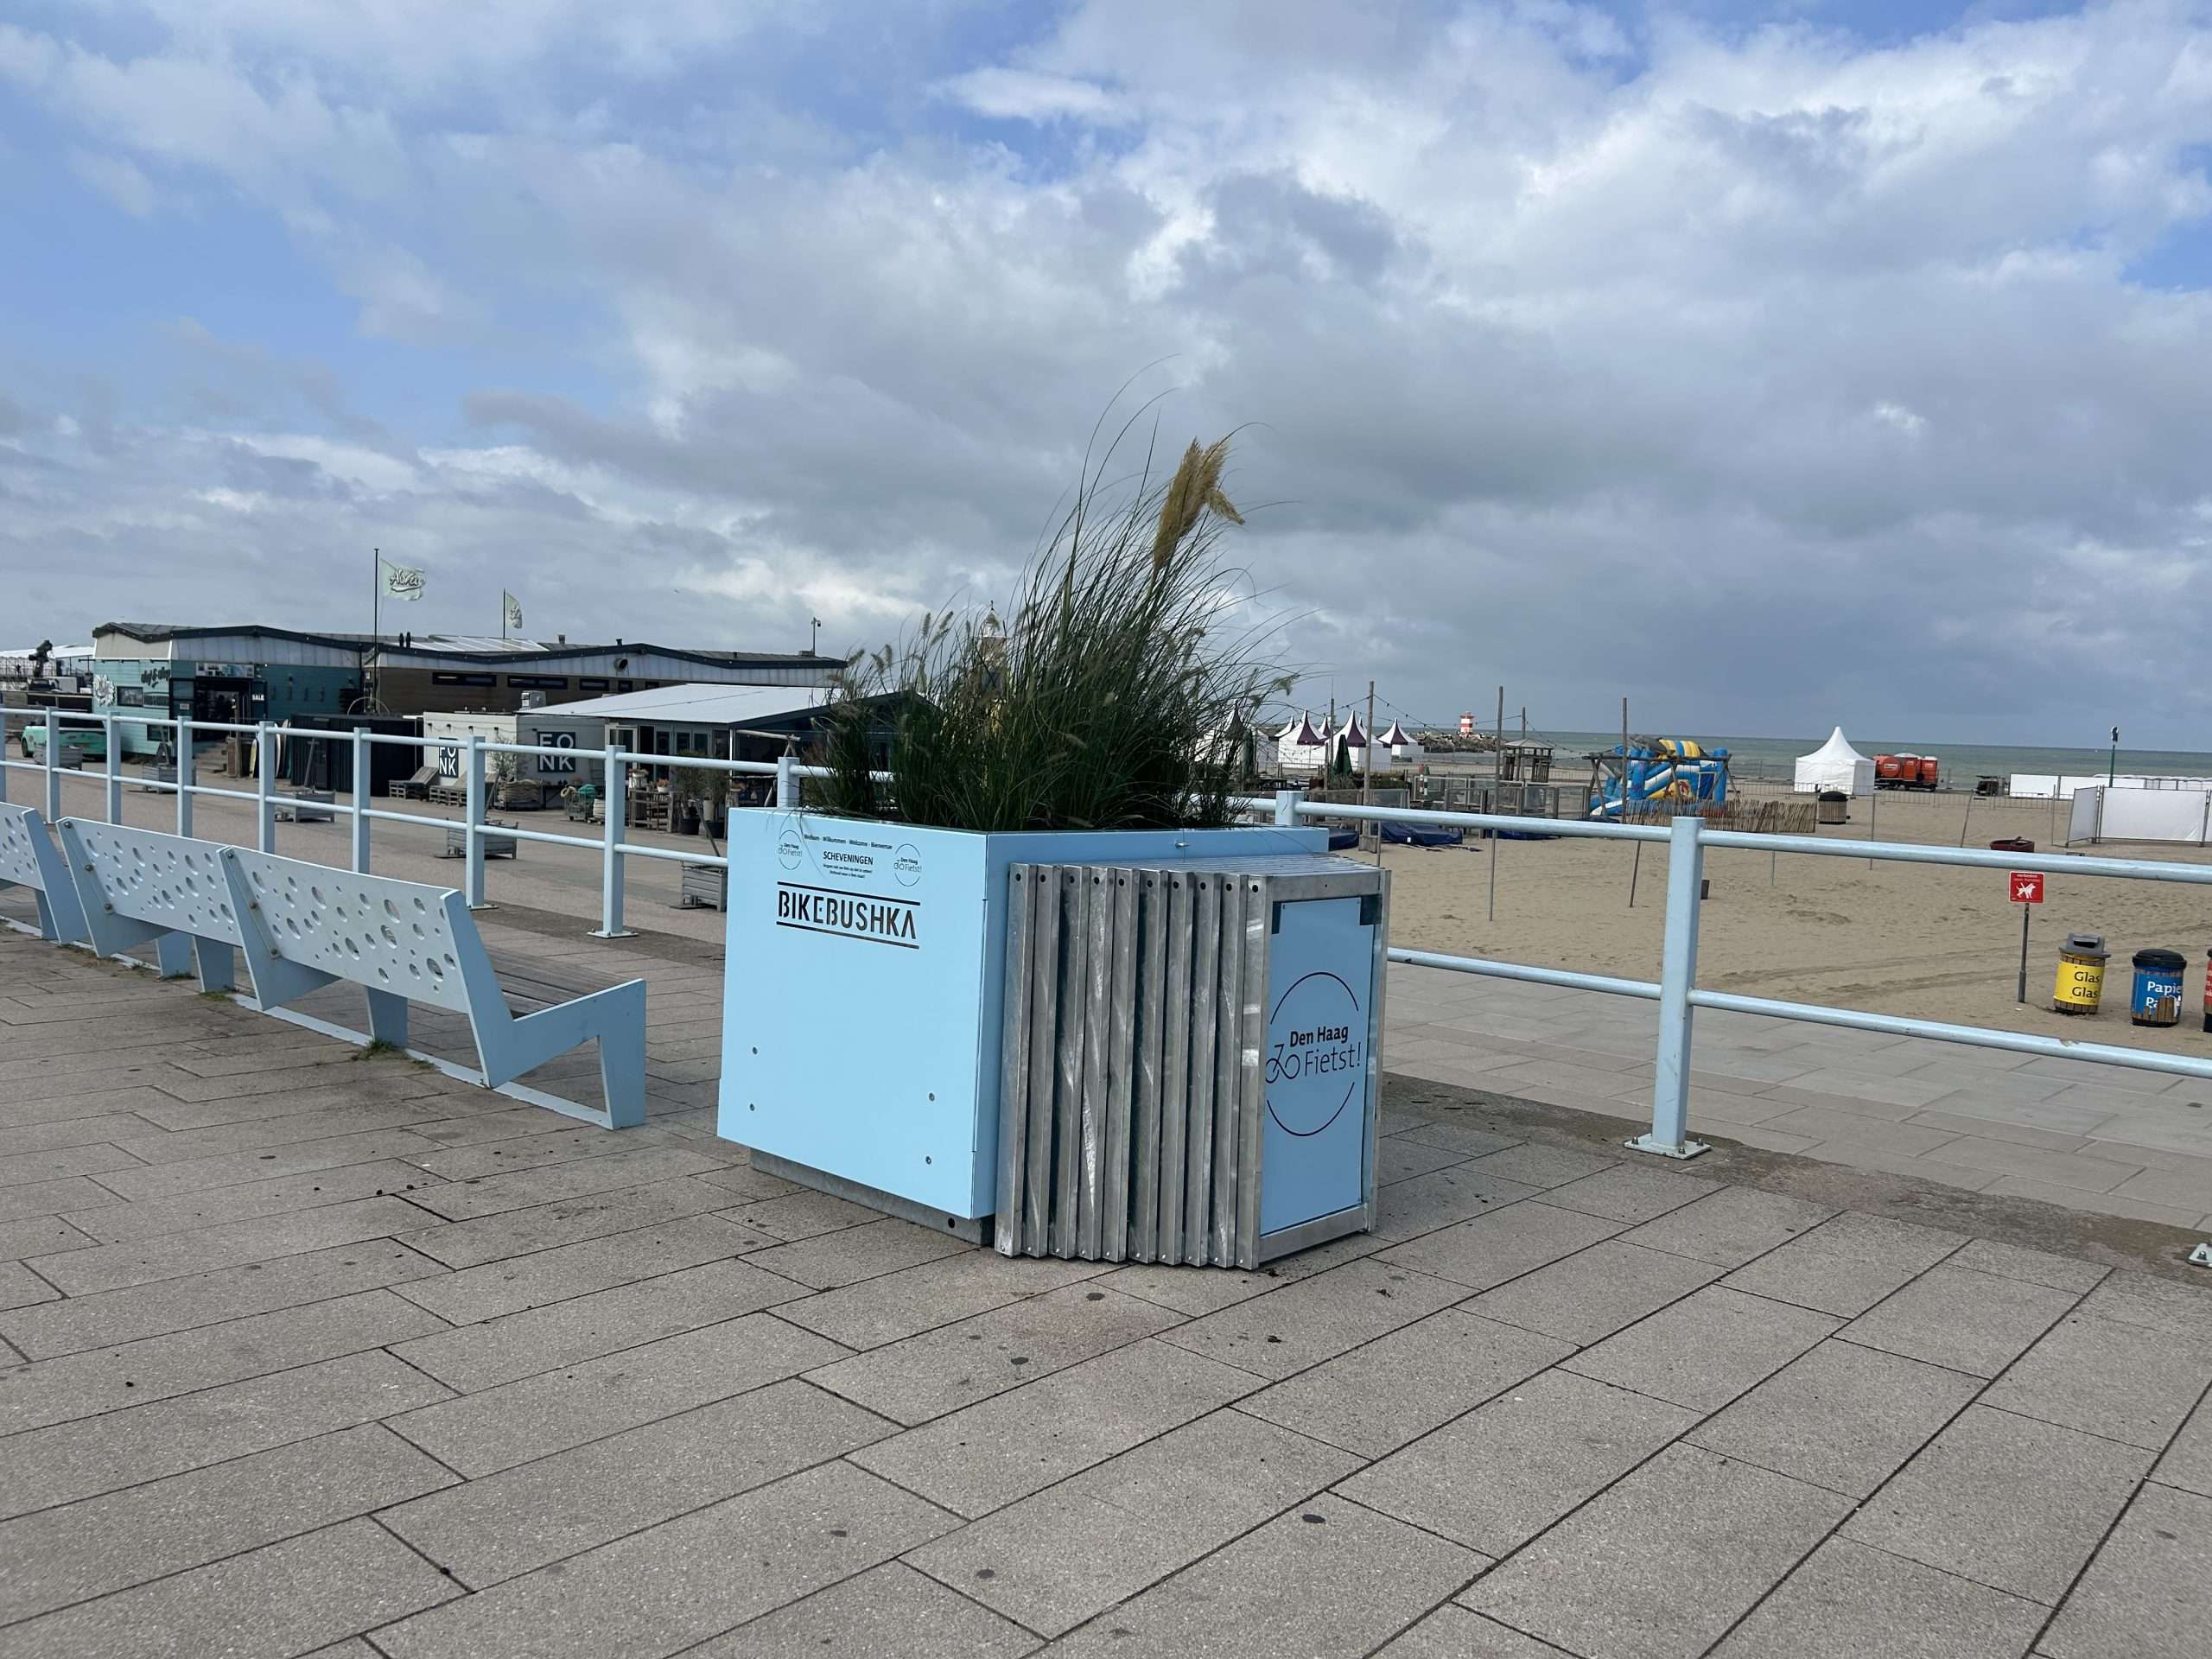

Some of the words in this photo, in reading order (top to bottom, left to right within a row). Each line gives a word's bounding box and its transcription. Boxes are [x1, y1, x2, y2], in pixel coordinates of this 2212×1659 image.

[540, 734, 574, 748] FO
[440, 757, 457, 776] NK
[540, 753, 574, 771] NK
[823, 850, 874, 865] SCHEVENINGEN
[778, 889, 917, 940] BIKEBUSHKA
[2074, 971, 2101, 983] Glas
[2071, 986, 2100, 999] Glas
[2146, 981, 2183, 996] Papie
[1289, 1030, 1314, 1048] Den
[1317, 1026, 1349, 1044] Haag
[1305, 1041, 1362, 1077] Fietst!
